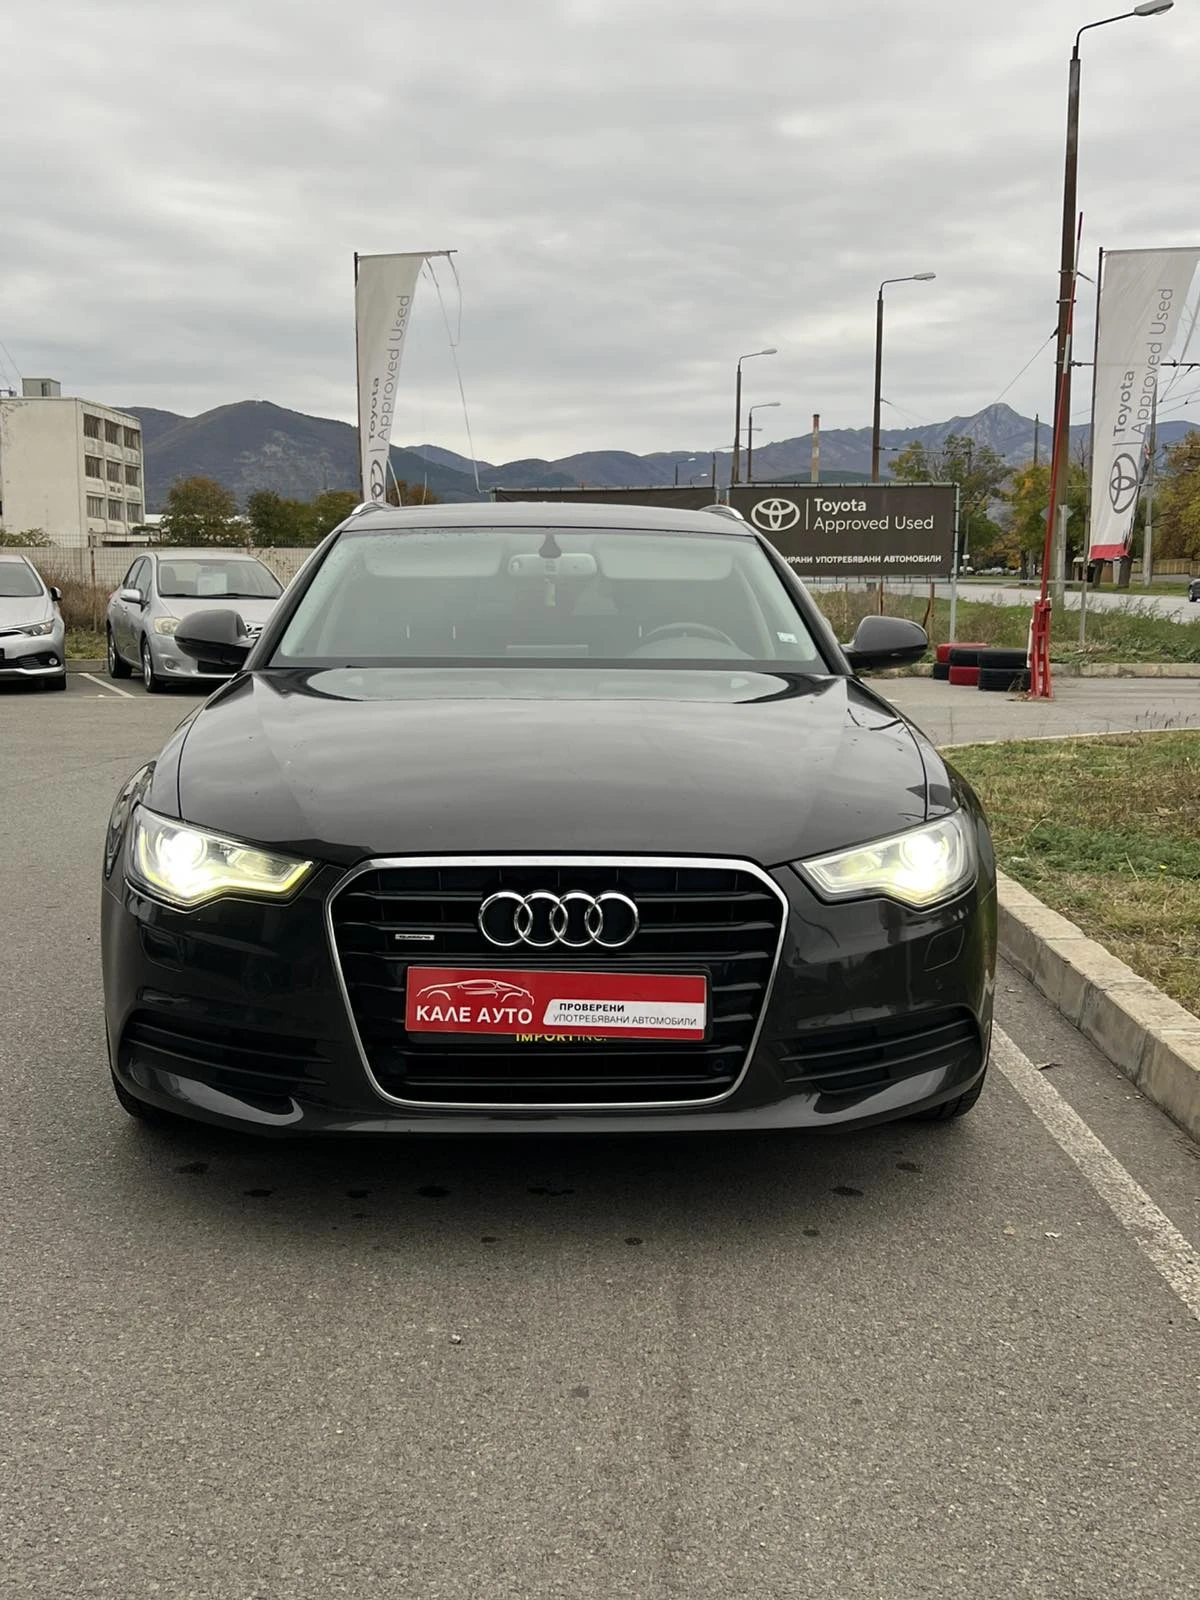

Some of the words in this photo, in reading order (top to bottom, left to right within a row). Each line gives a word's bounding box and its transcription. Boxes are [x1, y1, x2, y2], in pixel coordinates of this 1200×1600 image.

[377, 348, 400, 441] Approved
[390, 295, 410, 341] Used
[1131, 341, 1162, 434] Approved
[1149, 287, 1173, 335] Used
[369, 378, 379, 442] Toyota
[1113, 370, 1135, 436] Toyota
[814, 498, 867, 515] Toyota
[813, 516, 889, 534] Approved
[895, 516, 934, 530] Used
[815, 555, 881, 564] УПОТРЕБЯВАНИ
[883, 555, 942, 564] АВТОМОБИЛИ
[416, 1005, 471, 1023] КАЛЕ
[477, 1007, 533, 1025] АУТО
[559, 1003, 625, 1012] ПРОВЕРЕНИ
[553, 1014, 630, 1024] УПОТРЕБЯВАНИ
[632, 1016, 697, 1026] АВТОМОБИЛИ
